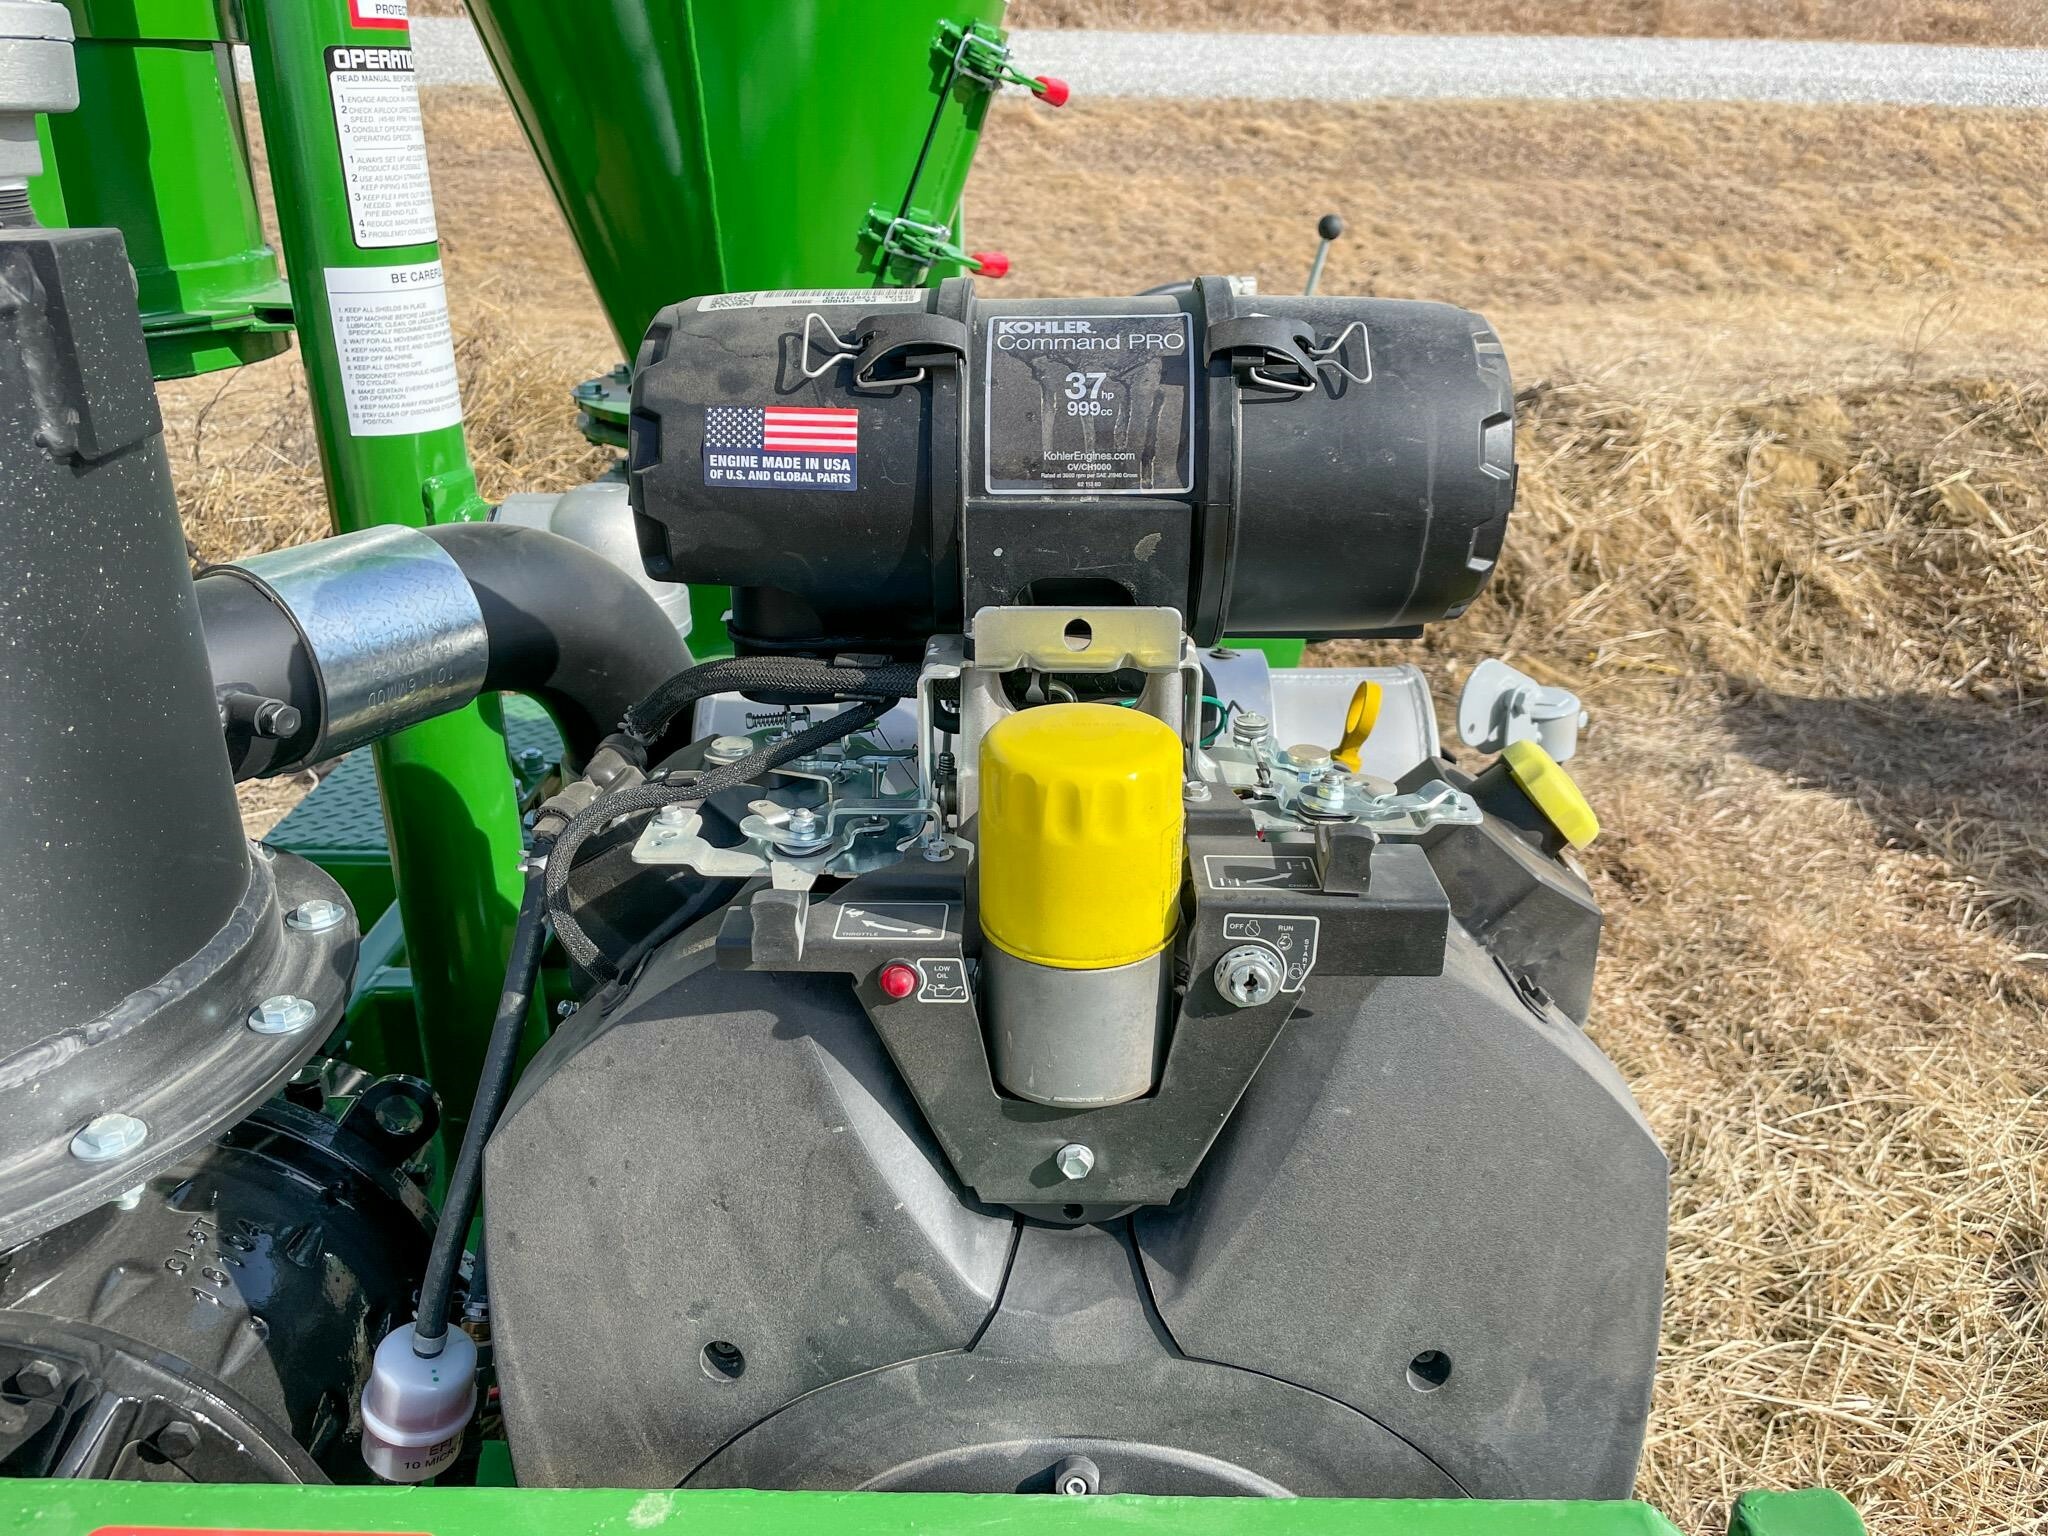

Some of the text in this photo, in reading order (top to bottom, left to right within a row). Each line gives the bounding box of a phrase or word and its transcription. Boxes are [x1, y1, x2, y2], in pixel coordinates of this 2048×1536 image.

[337, 74, 360, 82] READ
[361, 74, 391, 82] MANUAL
[339, 94, 345, 103] 1
[341, 105, 348, 114] 2
[344, 124, 351, 133] 3
[350, 155, 354, 163] 1
[351, 174, 358, 182] 2
[354, 192, 361, 201] 3
[359, 219, 365, 227] 4
[360, 230, 367, 238] 5
[391, 272, 407, 284] BE
[997, 333, 1185, 350] Command PRO
[1064, 372, 1115, 401] 37 hp
[1067, 401, 1113, 416] 999 cc
[1043, 451, 1136, 462] KohlerEngines.com
[709, 455, 851, 471] ENGINE MADE IN USA
[1067, 463, 1112, 471] CV/CH1000
[709, 469, 851, 484] OF U.S. AND GLOBAL PARTS
[404, 1461, 421, 1470] 10
